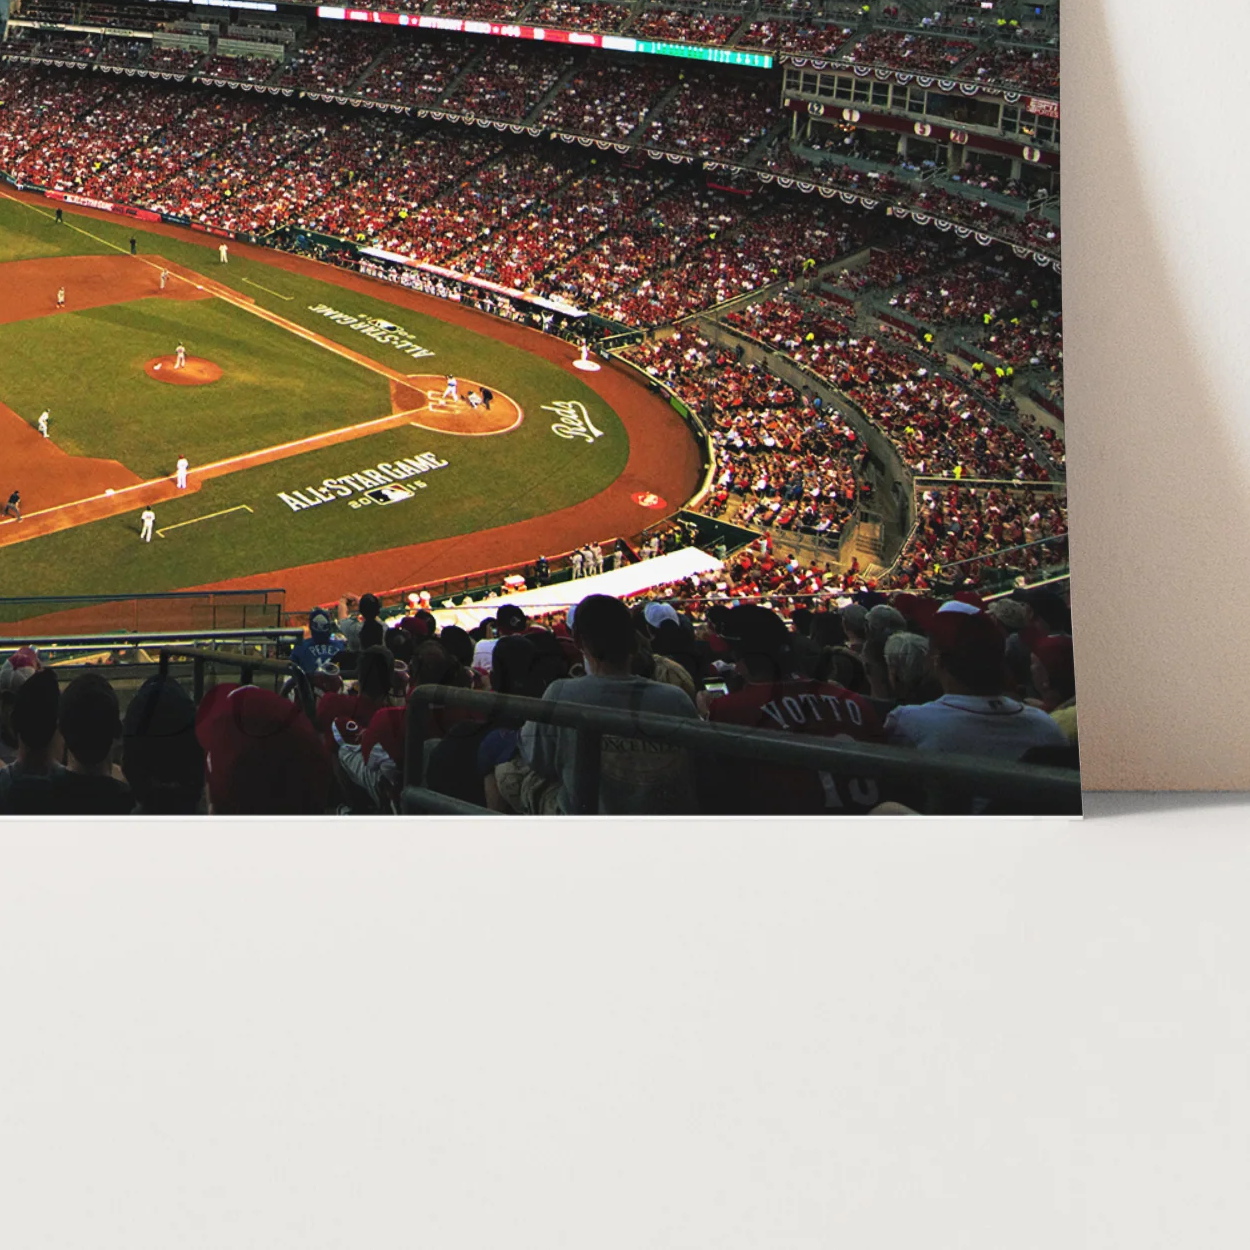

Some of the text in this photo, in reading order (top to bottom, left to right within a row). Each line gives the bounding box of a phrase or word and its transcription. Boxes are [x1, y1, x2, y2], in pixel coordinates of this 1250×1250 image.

[307, 303, 359, 325] GAME
[539, 400, 604, 444] Reds
[377, 451, 449, 480] GAME
[309, 644, 341, 656] PEREZ
[760, 694, 863, 729] VOTTO
